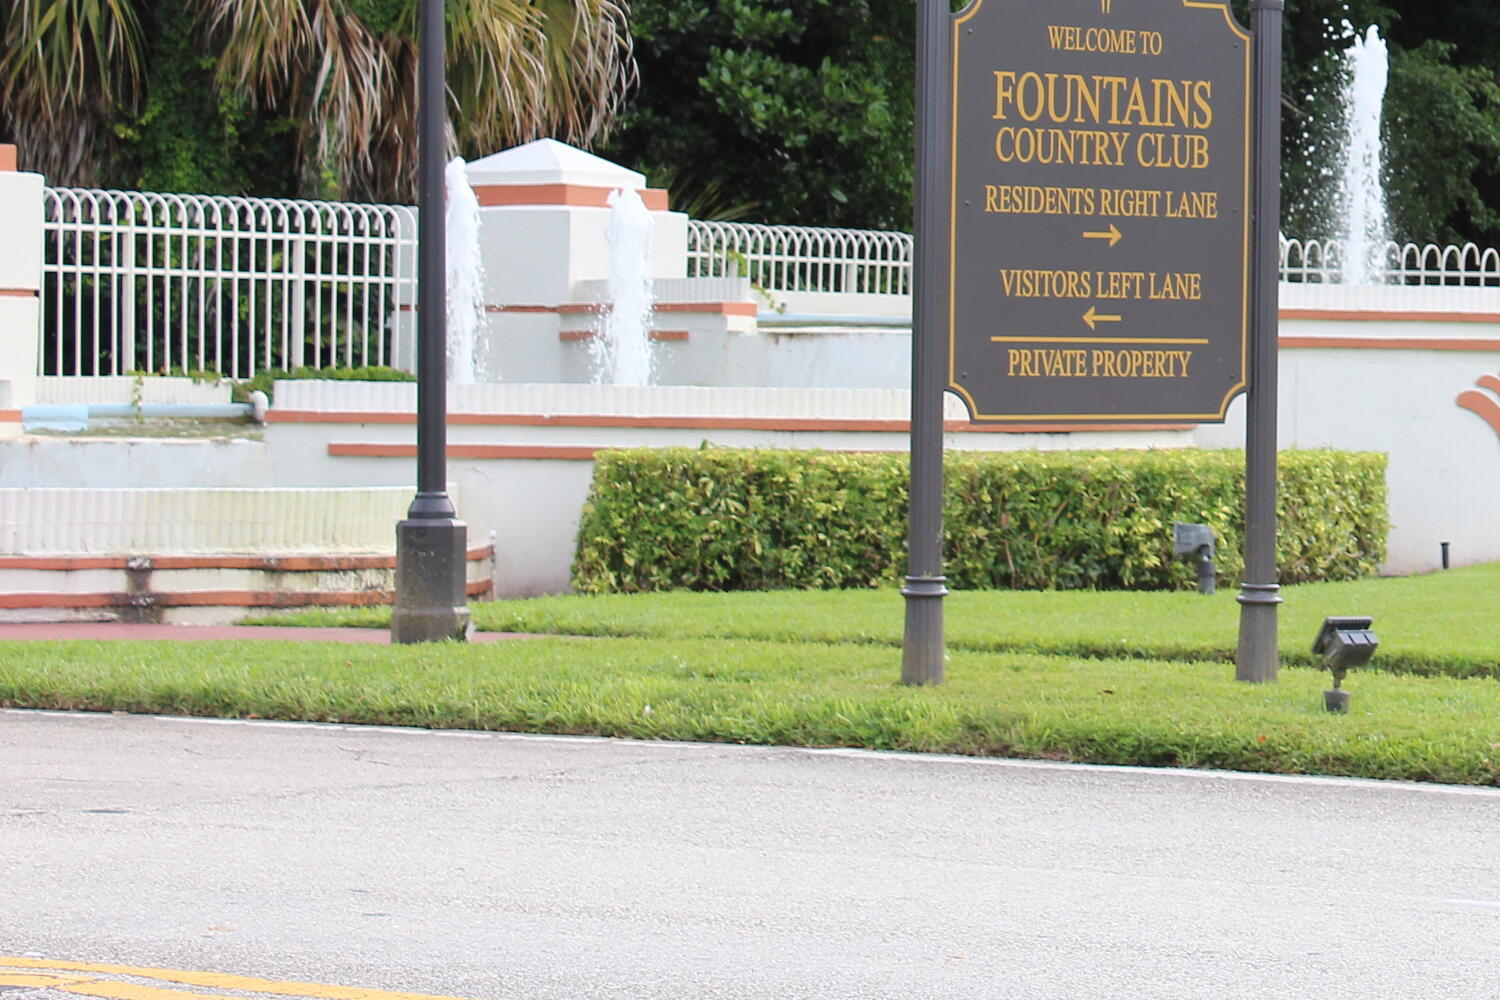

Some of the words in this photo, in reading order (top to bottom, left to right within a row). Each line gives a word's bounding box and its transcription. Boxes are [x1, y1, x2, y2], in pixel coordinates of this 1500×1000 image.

[1048, 26, 1136, 55] WELCOME
[1140, 31, 1163, 56] TO
[992, 70, 1213, 130] FOUNTAINS
[995, 126, 1130, 167] COUNTRY
[1136, 132, 1210, 169] CLUB
[985, 185, 1095, 216] RESIDENTS
[1100, 189, 1161, 218] RIGHT
[1165, 192, 1218, 219] LANE
[1001, 269, 1091, 299] VISITORS
[1096, 272, 1146, 300] LEFT
[1149, 273, 1202, 301] LANE
[1007, 349, 1088, 377] PRIVATE
[1091, 350, 1193, 379] PROPERTY
